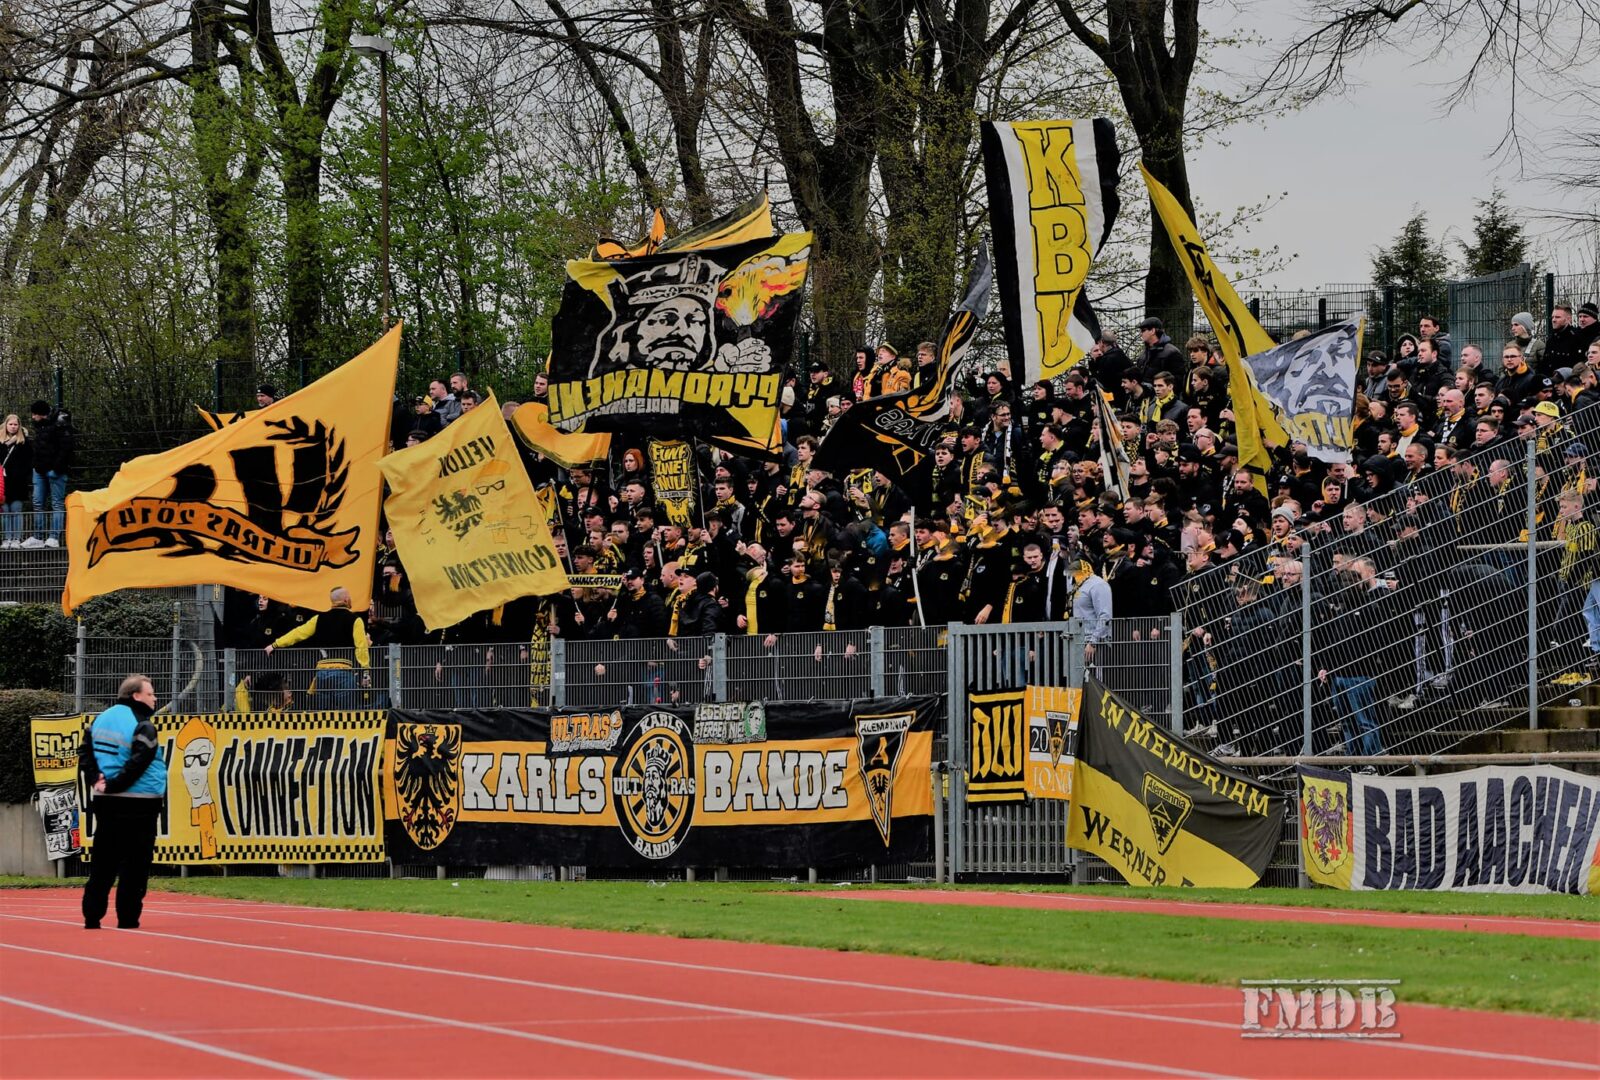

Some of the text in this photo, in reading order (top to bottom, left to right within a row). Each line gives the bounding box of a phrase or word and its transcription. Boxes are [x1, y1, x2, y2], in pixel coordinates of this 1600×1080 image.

[657, 474, 687, 491] NULL
[551, 713, 611, 742] ULTRAS
[639, 713, 684, 735] KARLS
[1100, 690, 1271, 818] IN MEMORIAM
[218, 735, 380, 837] CONNECTION
[461, 749, 850, 815] KARLS BANDE
[1147, 778, 1187, 809] Alemannia
[635, 836, 678, 858] BANDE
[1080, 805, 1167, 886] WERNER
[1363, 776, 1600, 895] BAD AACHEN
